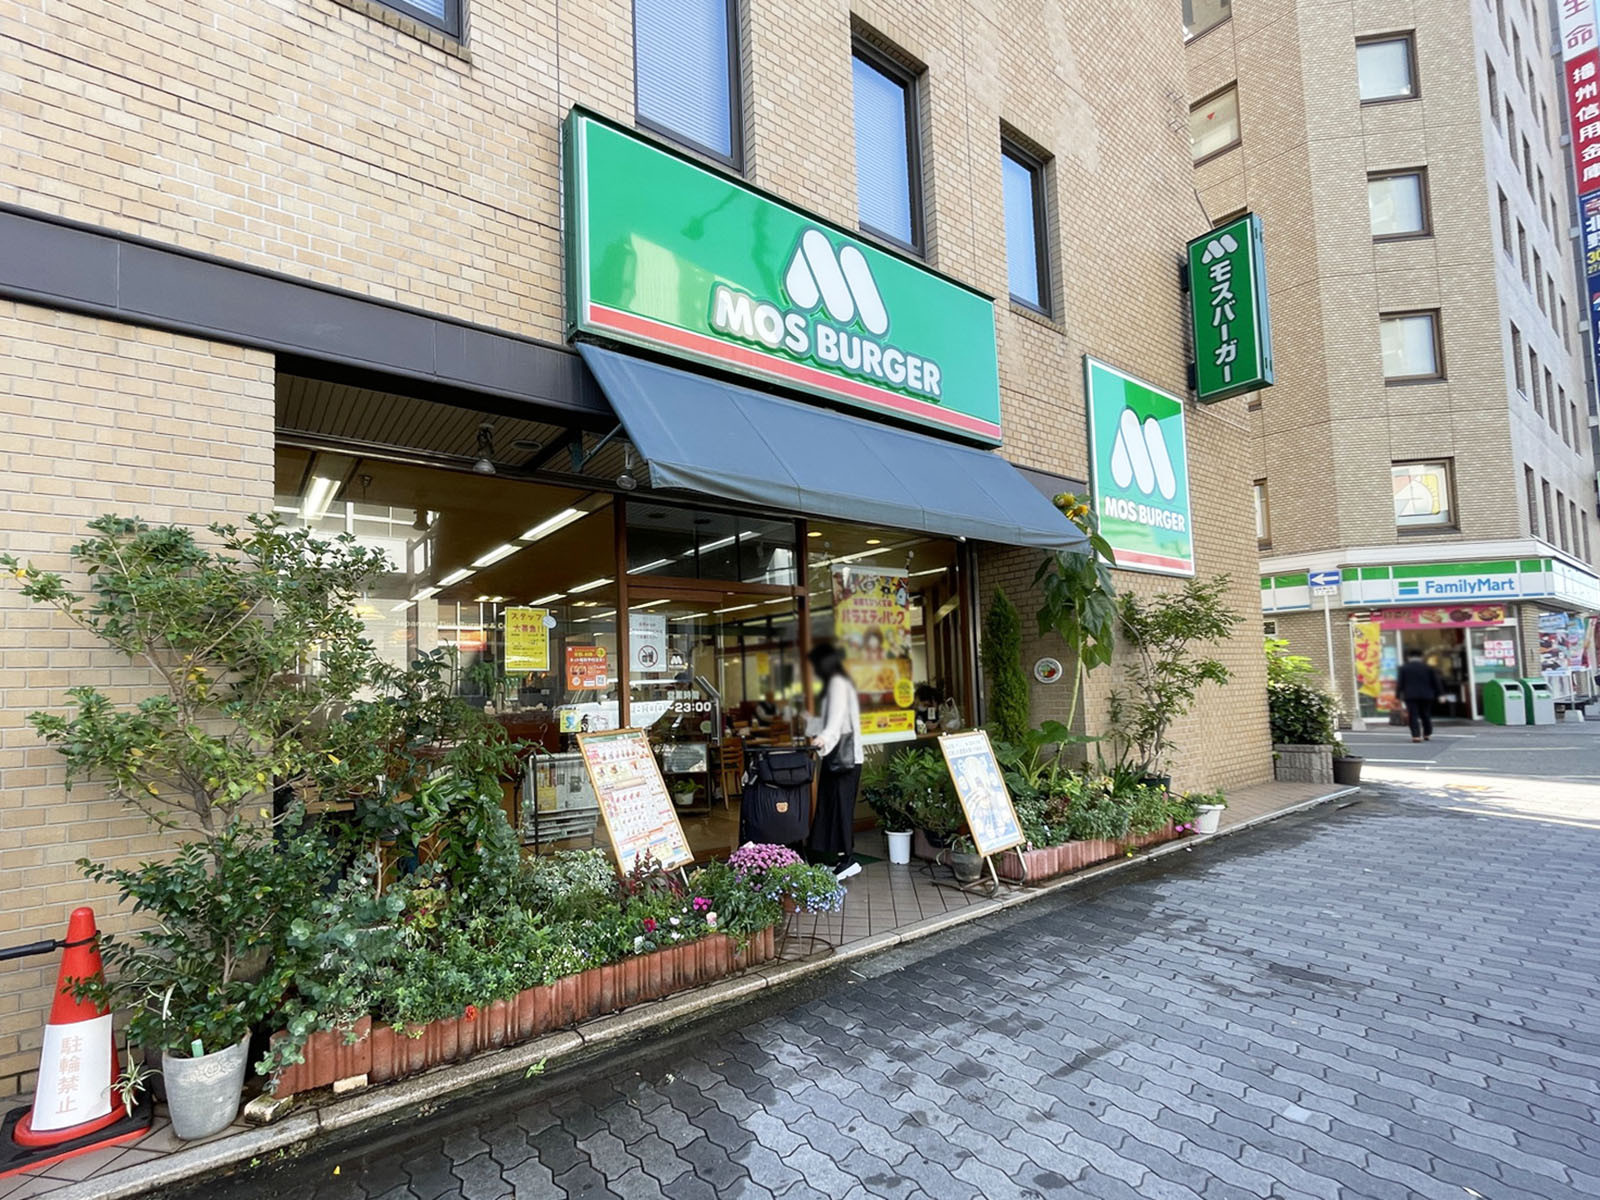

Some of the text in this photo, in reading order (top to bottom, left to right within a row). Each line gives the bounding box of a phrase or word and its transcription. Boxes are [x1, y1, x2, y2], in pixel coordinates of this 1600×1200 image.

[1573, 61, 1600, 182] 播州信用金庫
[715, 289, 941, 395] MOS BURGER
[1210, 259, 1238, 383] モスバーガー
[1105, 496, 1185, 532] MOS BURGER
[1425, 578, 1515, 594] FamilyMart
[56, 1035, 83, 1114] 駐輪禁止
